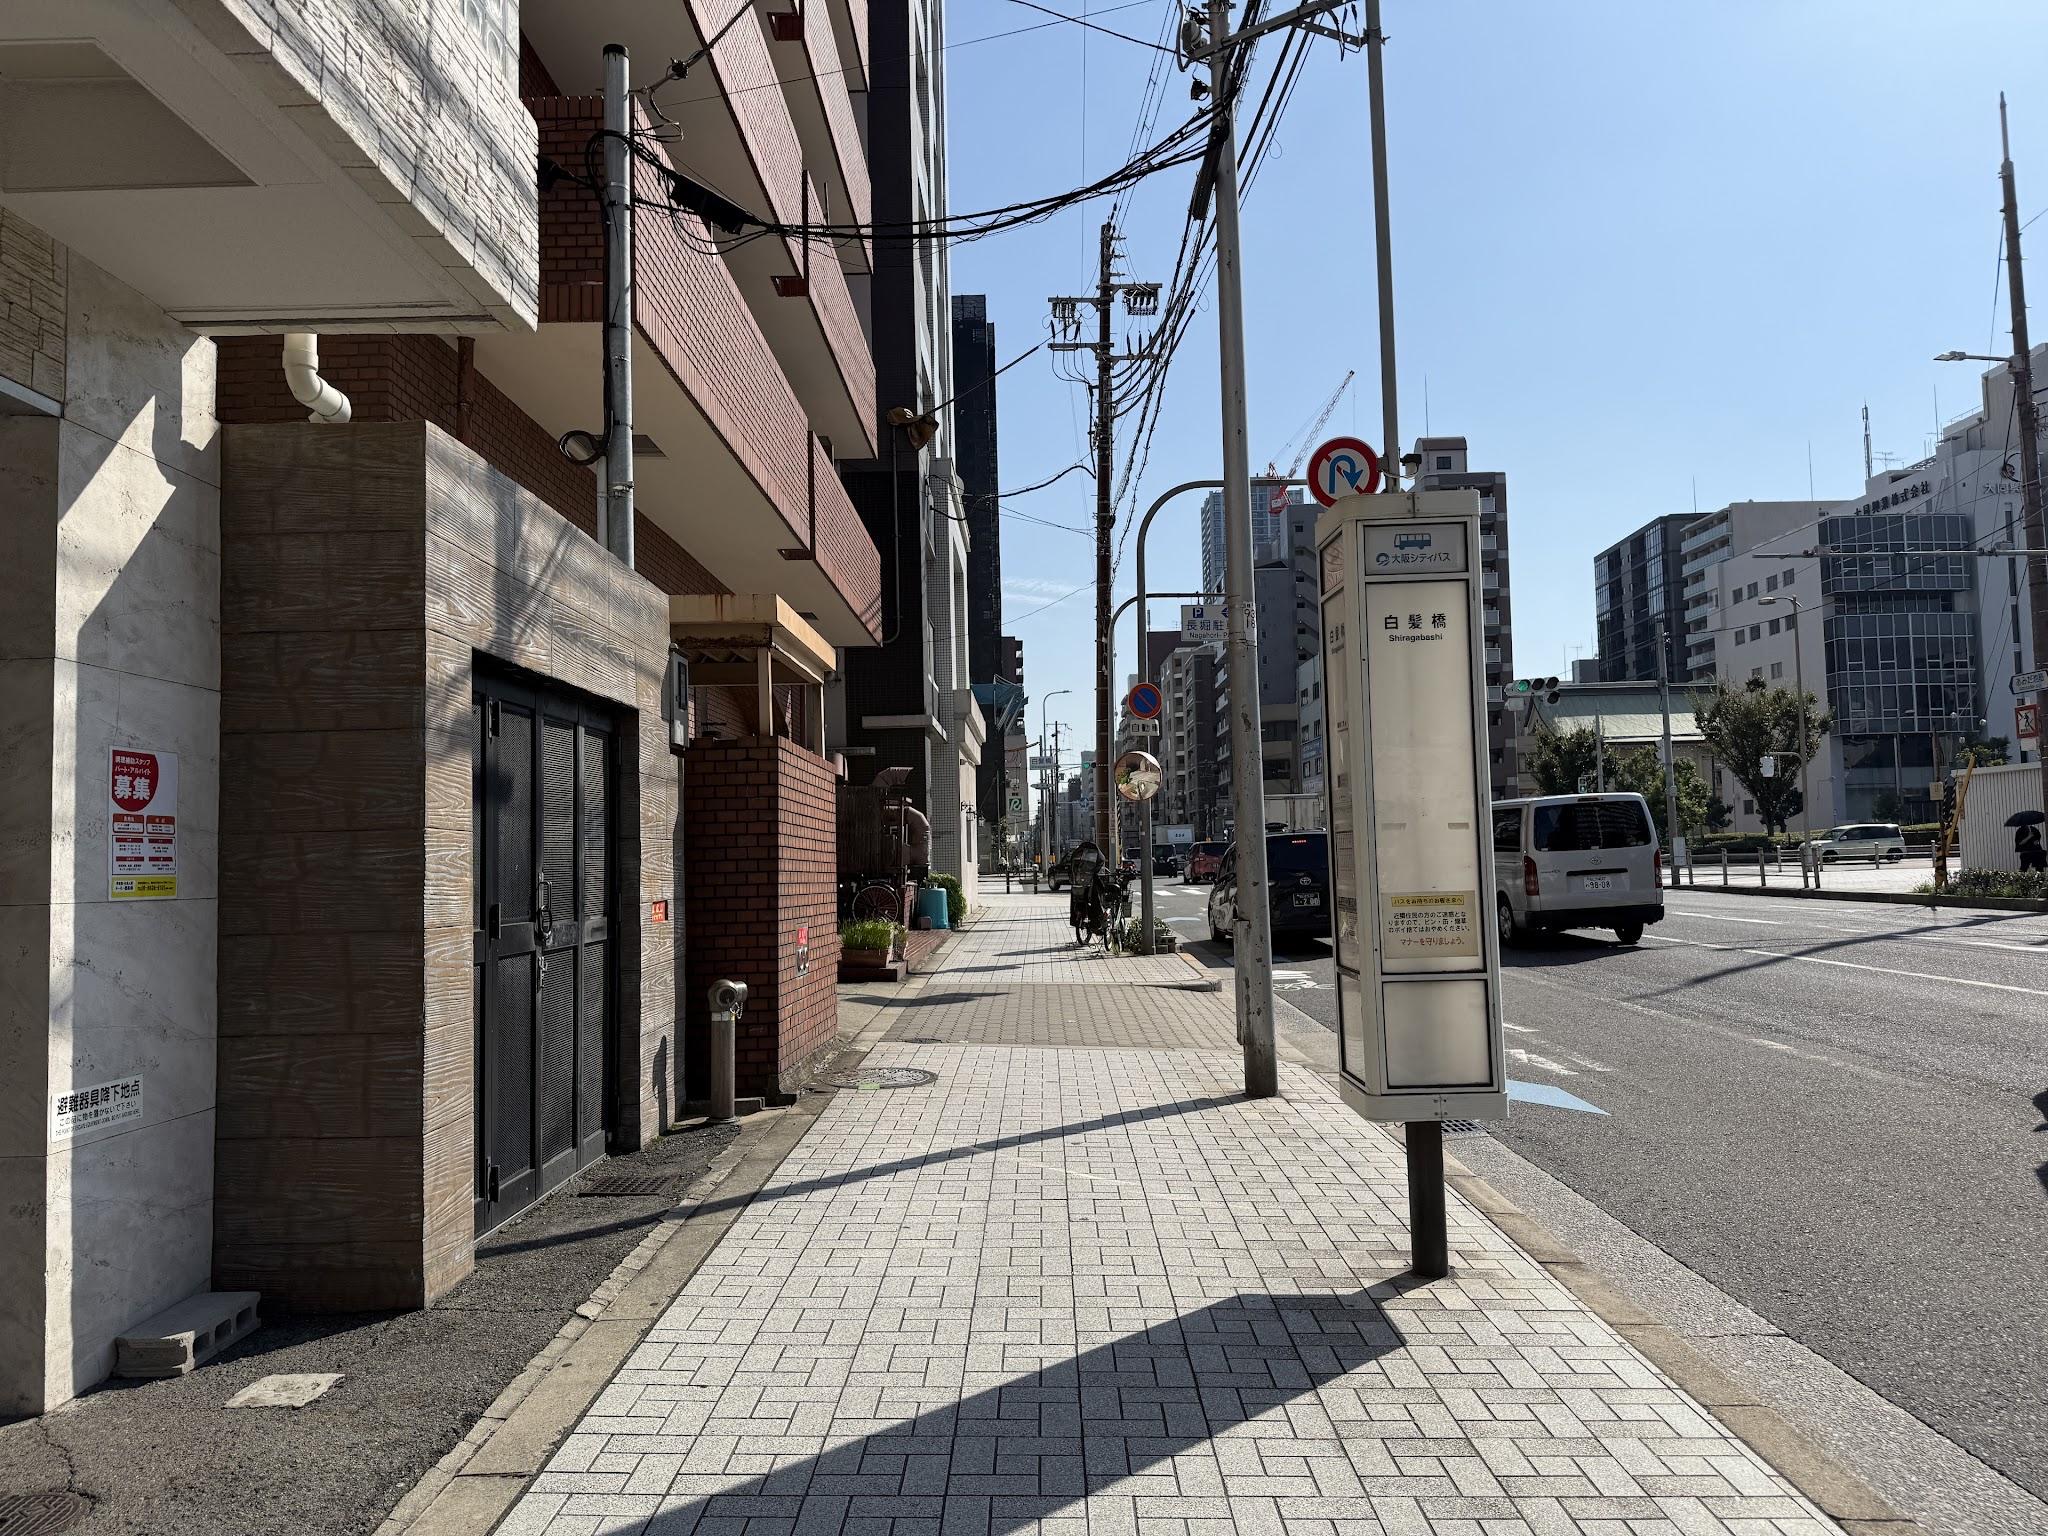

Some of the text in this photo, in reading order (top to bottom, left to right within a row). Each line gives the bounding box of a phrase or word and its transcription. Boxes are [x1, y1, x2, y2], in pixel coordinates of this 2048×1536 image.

[1391, 551, 1451, 564] 大阪シティバス
[1187, 619, 1229, 631] 長堀駐
[1384, 612, 1447, 630] 白髪橋
[1388, 633, 1443, 642] Shiragabashi
[114, 774, 150, 800] 募集
[1400, 936, 1465, 946] マナーを守りましょう。
[56, 1079, 141, 1116] 避難器具降下地点
